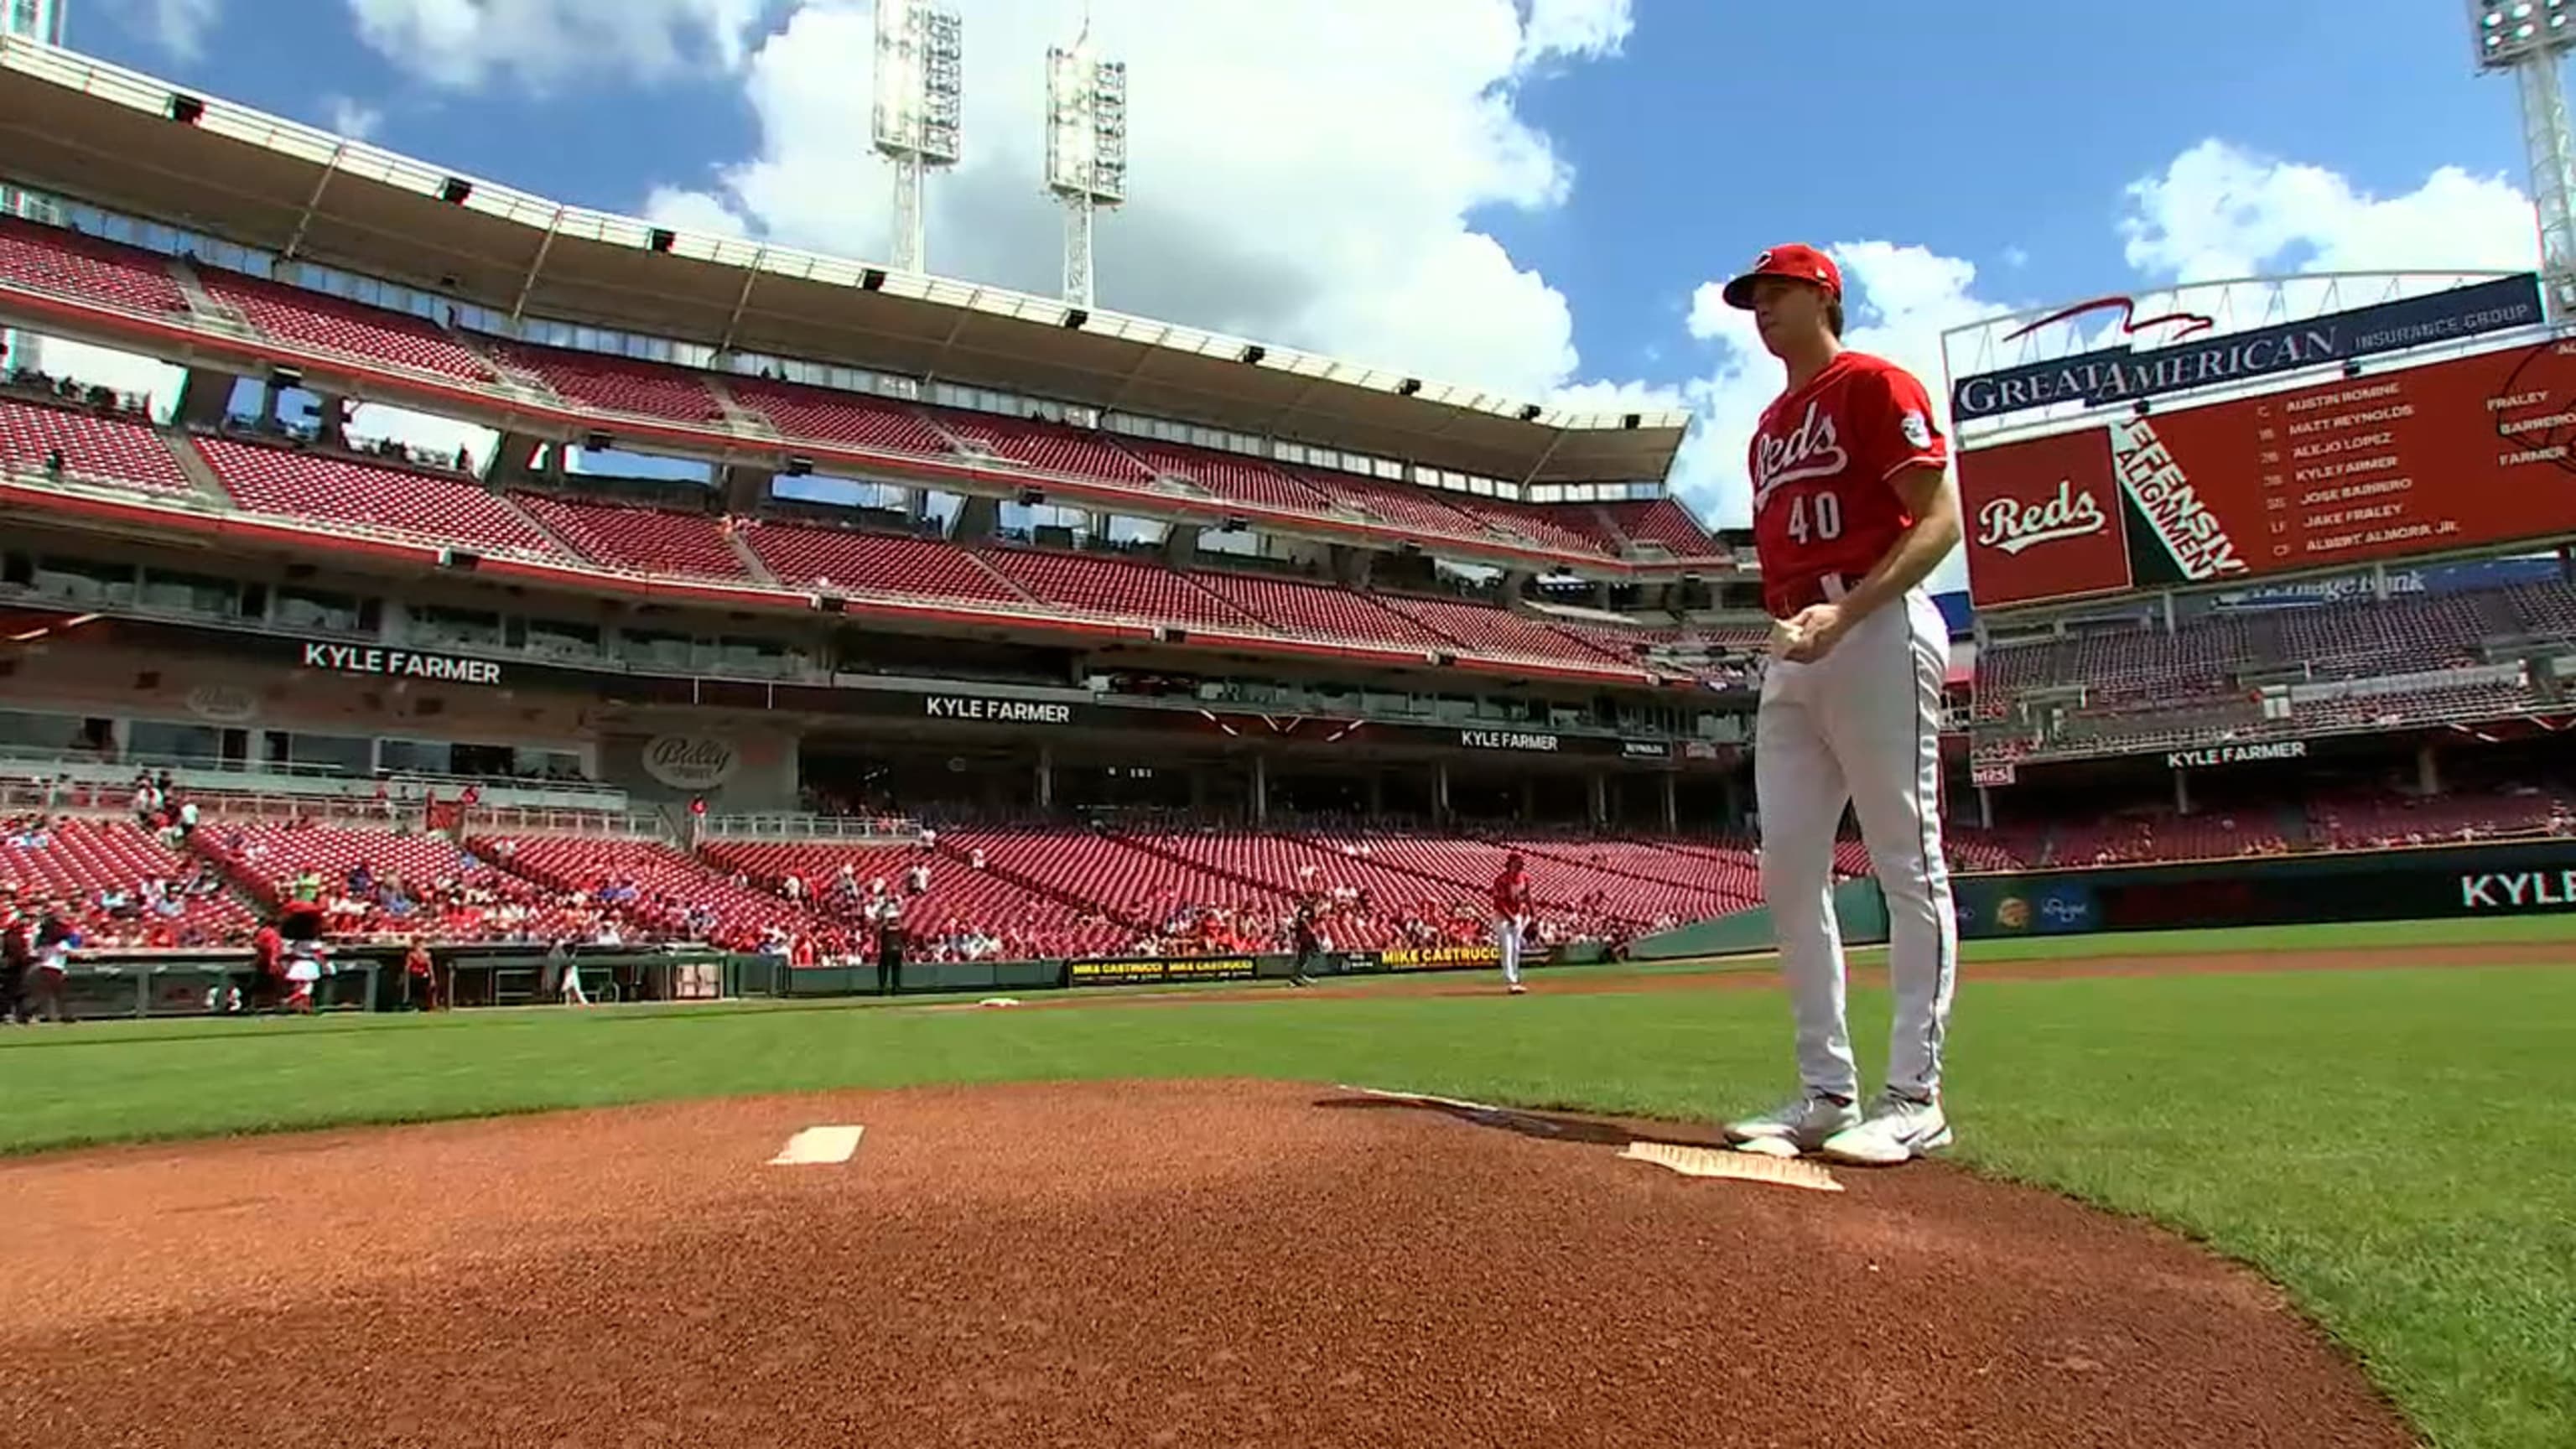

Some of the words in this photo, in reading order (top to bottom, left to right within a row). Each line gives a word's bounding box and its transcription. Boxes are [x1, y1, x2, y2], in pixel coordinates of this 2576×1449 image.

[2355, 317, 2457, 349] INSURANCE
[2463, 304, 2528, 328] GROUP
[2287, 394, 2340, 412] AUSTIN
[2342, 382, 2400, 402] ROMINE
[2487, 391, 2549, 411] FRALEY
[2289, 418, 2332, 435] MATT
[2334, 404, 2414, 427] REYNOLDS
[2293, 441, 2342, 459] ALEJO
[2345, 432, 2393, 450] LOPEZ
[2499, 446, 2567, 466] FARMER
[2295, 467, 2334, 483] KYLE
[2336, 455, 2397, 475] FARMER
[2300, 491, 2339, 506] JOSE
[2341, 478, 2412, 498] BARRERO
[1789, 491, 1841, 544] 40
[1978, 480, 2106, 554] Reds
[2303, 513, 2343, 528] JAKE
[2346, 503, 2402, 522] FRALEY
[2307, 535, 2363, 552] ALBERT
[2365, 524, 2431, 543] ALMORA
[304, 643, 383, 672] KYLE
[388, 652, 501, 684] FARMER
[927, 696, 983, 718] KYLE
[987, 700, 1070, 723] FARMER
[1462, 730, 1500, 748] KYLE
[1502, 732, 1558, 751] FARMER
[2167, 750, 2221, 767] KYLE
[2222, 741, 2307, 762] FARMER
[2461, 870, 2576, 906] KYLE
[1072, 963, 1100, 974] MIKE
[1102, 962, 1163, 974] CASTRUCCI
[1168, 961, 1194, 971] MIKE
[1196, 959, 1254, 971] CASTRUCCI
[1382, 949, 1419, 964] MIKE
